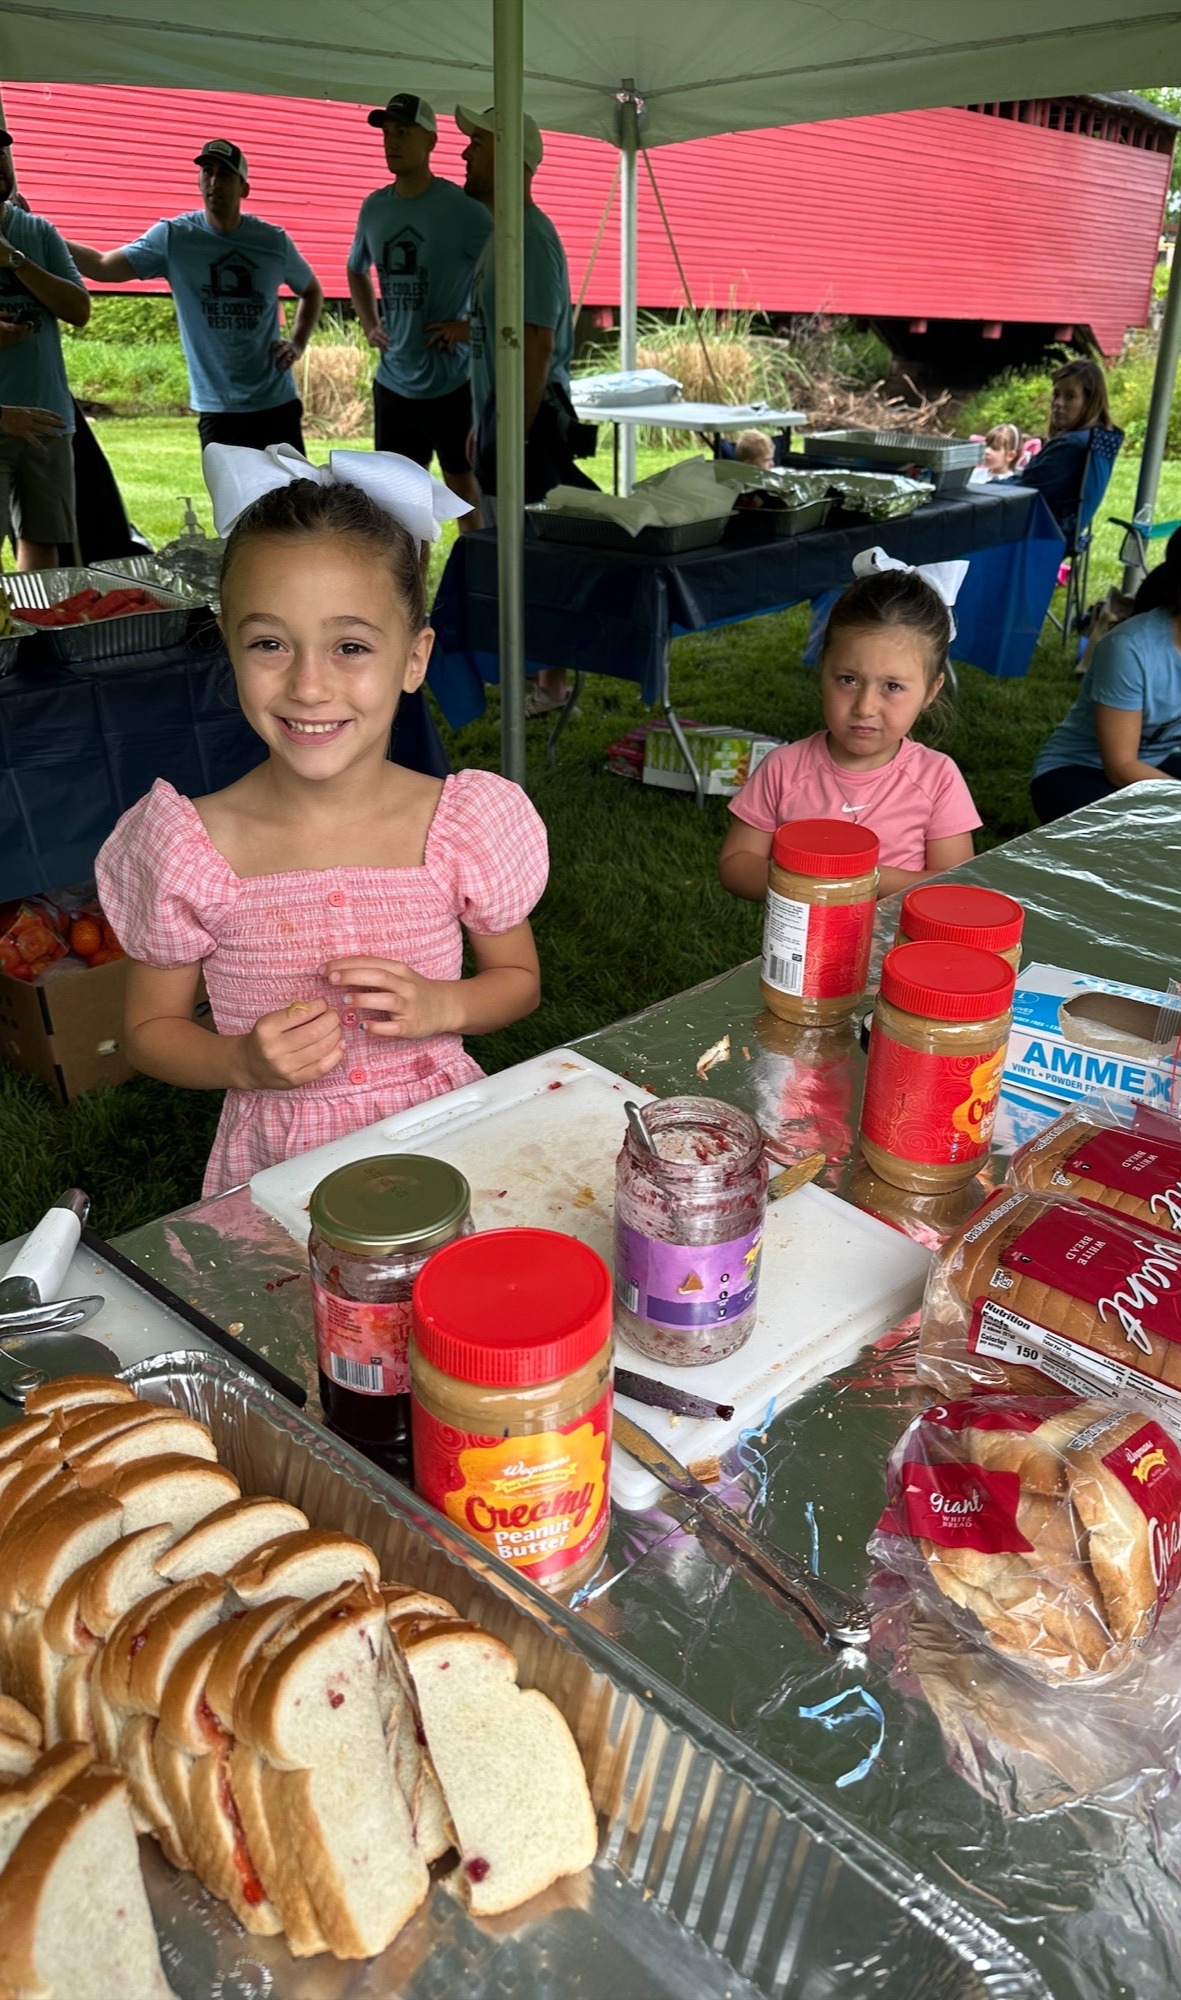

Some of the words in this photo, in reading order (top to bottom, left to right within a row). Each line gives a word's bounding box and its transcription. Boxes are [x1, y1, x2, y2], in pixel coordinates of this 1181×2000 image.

[201, 302, 220, 315] THE
[222, 302, 265, 317] COOLEST
[207, 316, 232, 329] REST
[235, 316, 260, 330] STOP
[1012, 1062, 1037, 1078] VINYL
[1045, 1073, 1083, 1092] POWDER
[1022, 1040, 1175, 1102] AMMEX
[1121, 1150, 1147, 1168] BREAD
[1132, 1154, 1159, 1172] WHITE
[1065, 1235, 1093, 1260] BREAD
[1076, 1240, 1106, 1266] WHITE
[986, 1301, 1032, 1331] Nutrition
[980, 1332, 1008, 1347] Calories
[1041, 1338, 1054, 1348] Total
[1053, 1344, 1063, 1352] Fat
[1016, 1344, 1039, 1361] 150
[501, 1456, 570, 1479] Wegmans
[464, 1482, 596, 1533] Creamy
[929, 1488, 984, 1513] giant
[494, 1518, 571, 1546] Peanut
[497, 1535, 570, 1559] Butter
